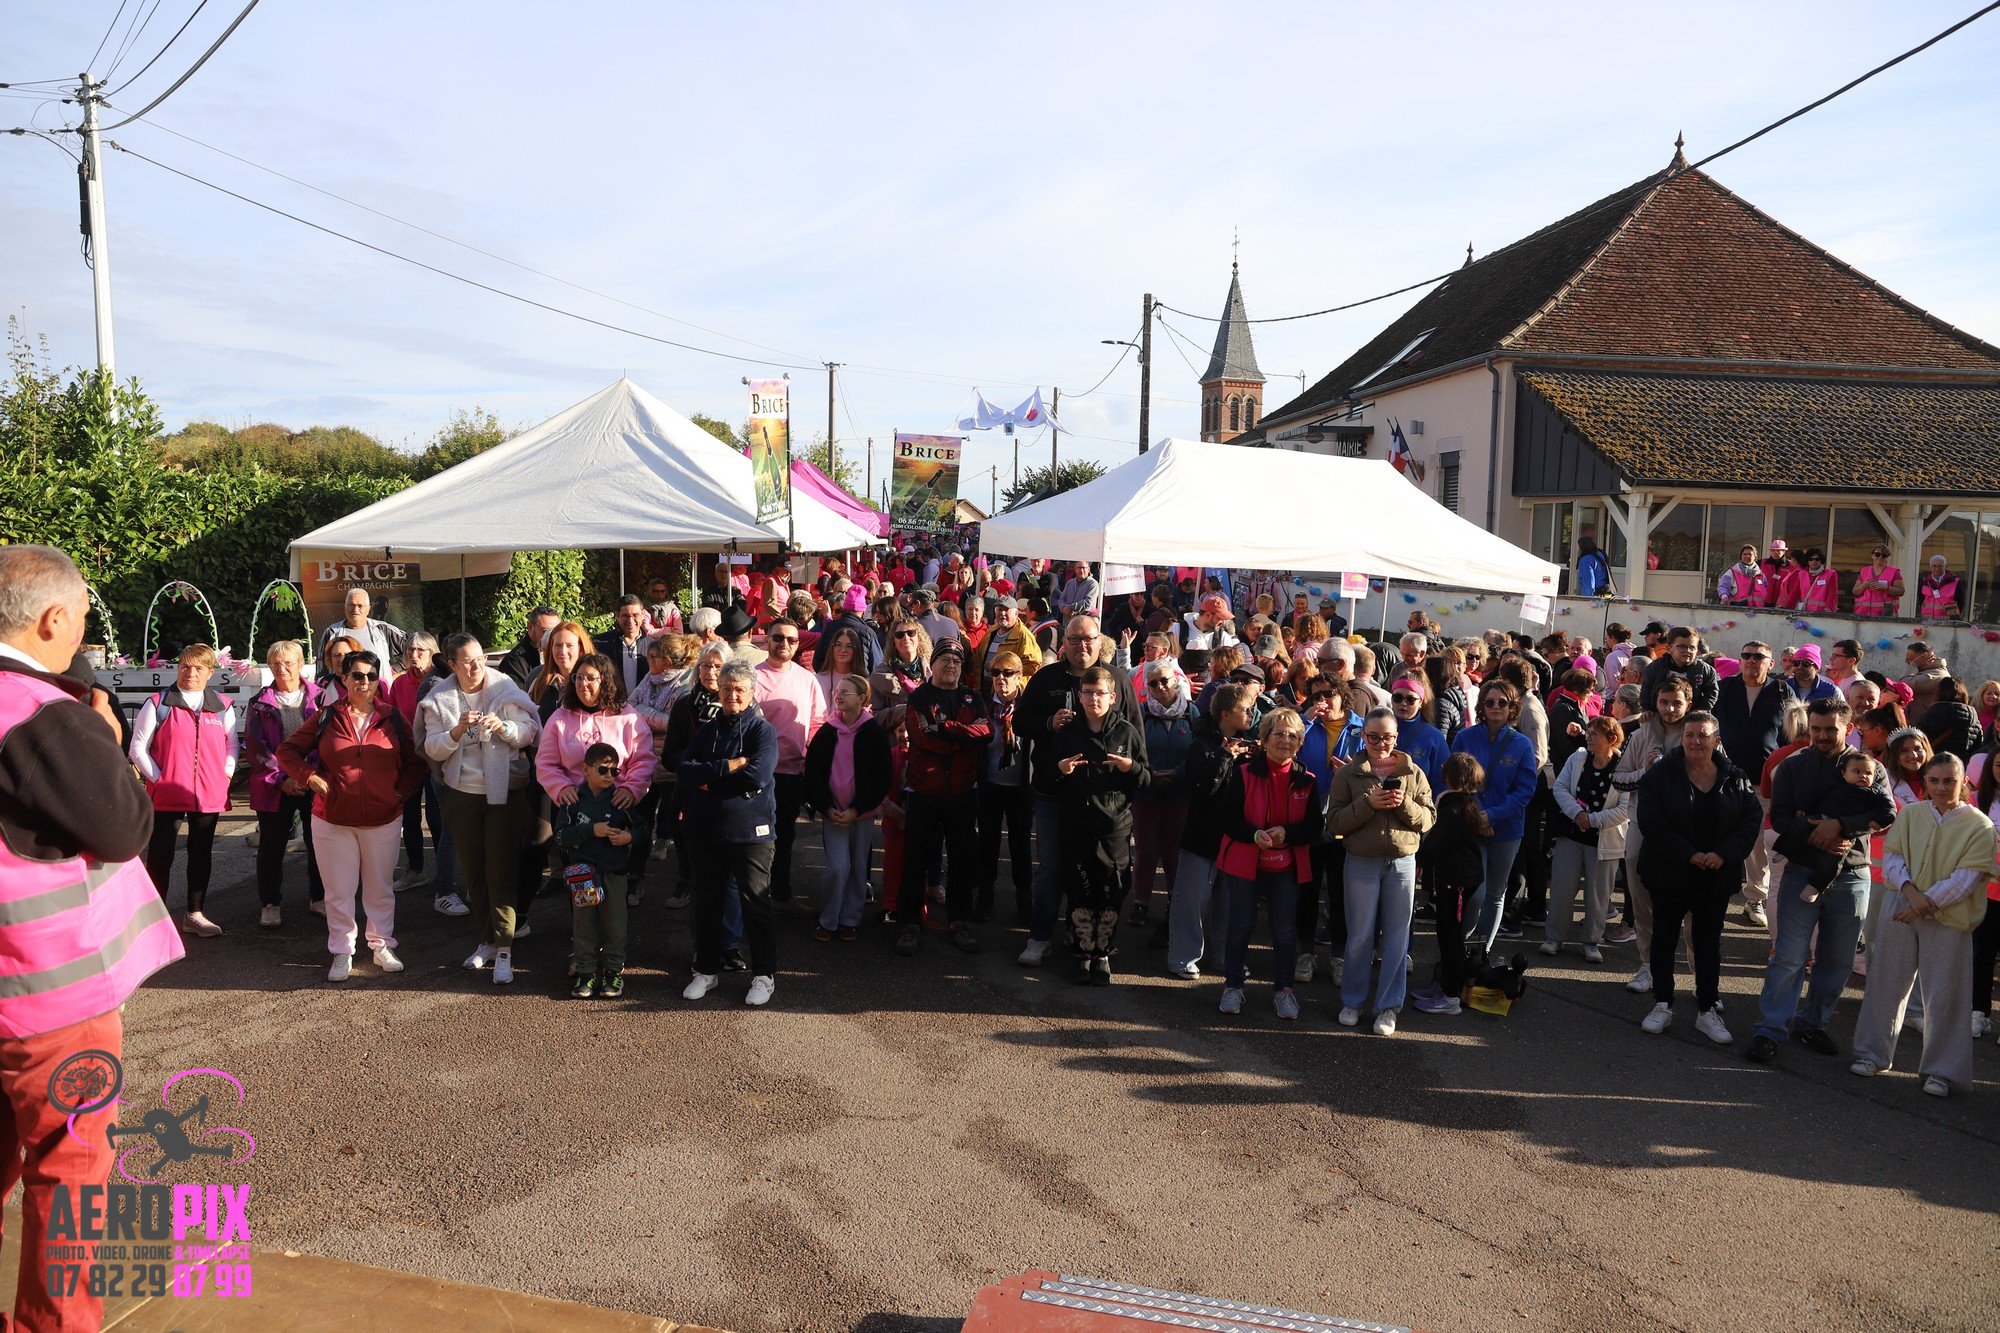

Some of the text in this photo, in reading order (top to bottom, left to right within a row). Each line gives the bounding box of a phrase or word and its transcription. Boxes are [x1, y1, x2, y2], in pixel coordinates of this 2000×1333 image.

[752, 393, 784, 414] BRICE
[900, 441, 955, 460] BRICE
[1337, 440, 1362, 457] MAIRIE
[316, 560, 408, 582] BRICE
[1106, 573, 1142, 582] INSCRIPTIONS
[337, 581, 395, 591] CHAMPAGNE
